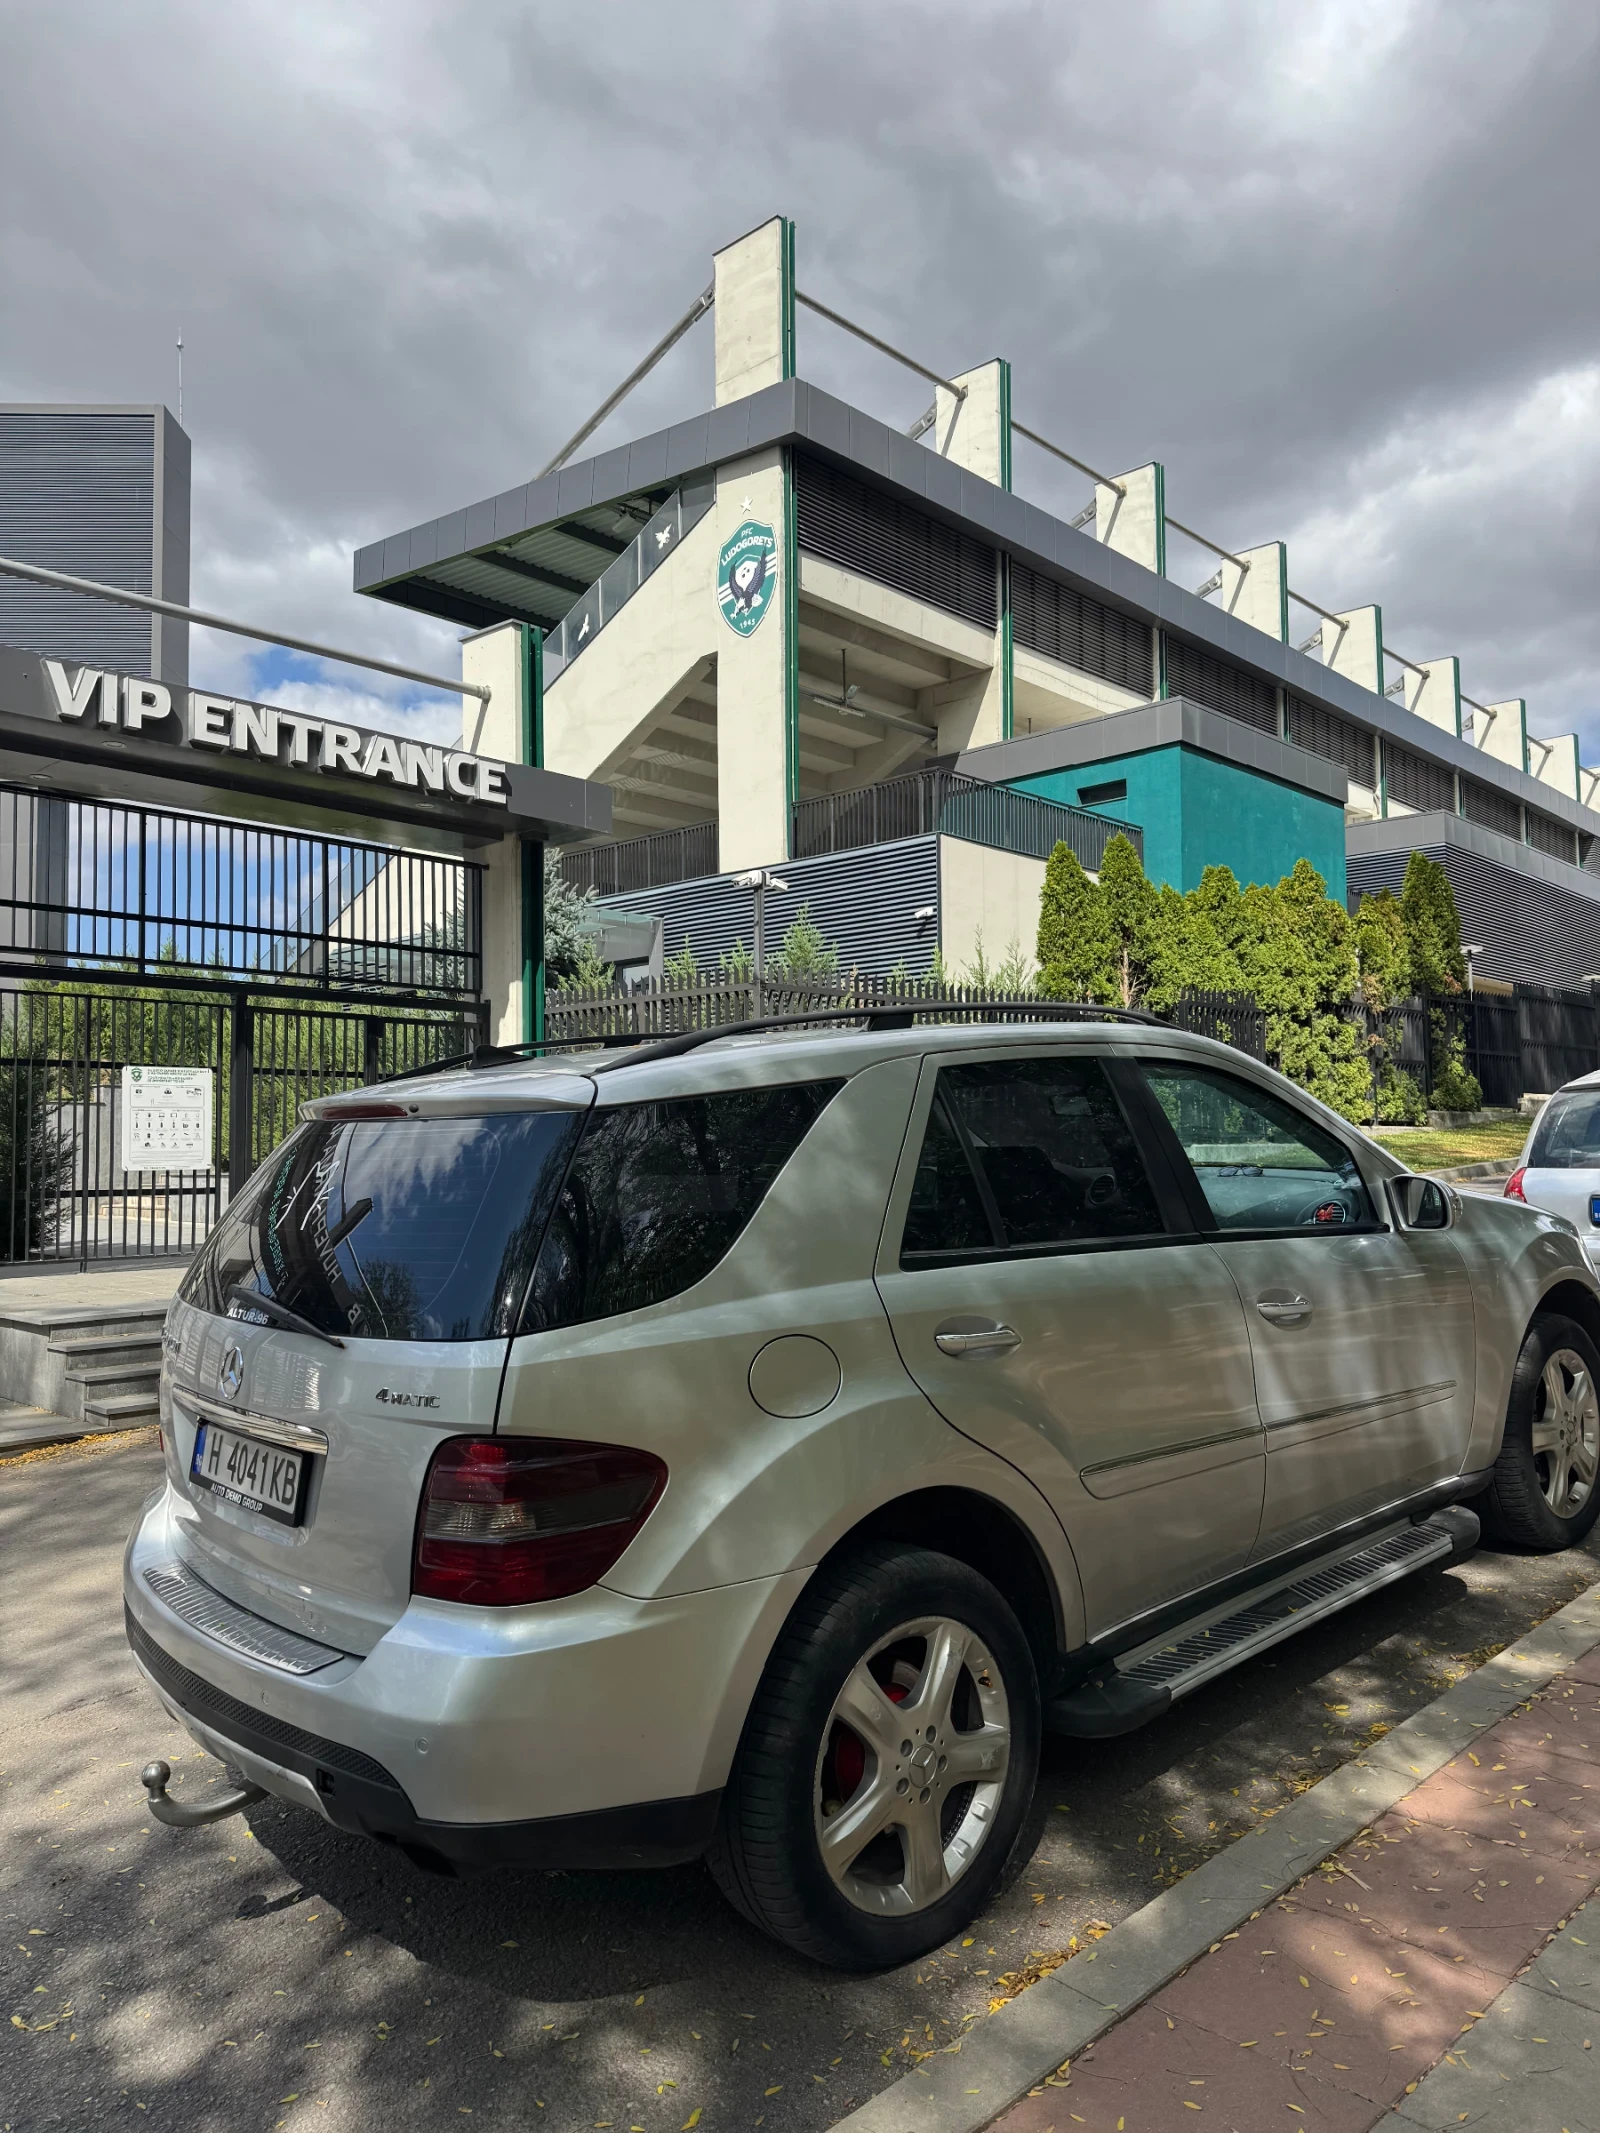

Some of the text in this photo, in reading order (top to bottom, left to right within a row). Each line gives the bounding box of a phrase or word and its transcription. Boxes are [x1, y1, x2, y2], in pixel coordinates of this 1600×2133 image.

[741, 528, 753, 538] PFC
[721, 536, 773, 566] LUDOGORETS
[740, 619, 755, 629] 1945
[41, 657, 507, 805] VIP ENTRANCE
[208, 1433, 223, 1475] H
[210, 1483, 263, 1512] AUTO DEMO GROUP
